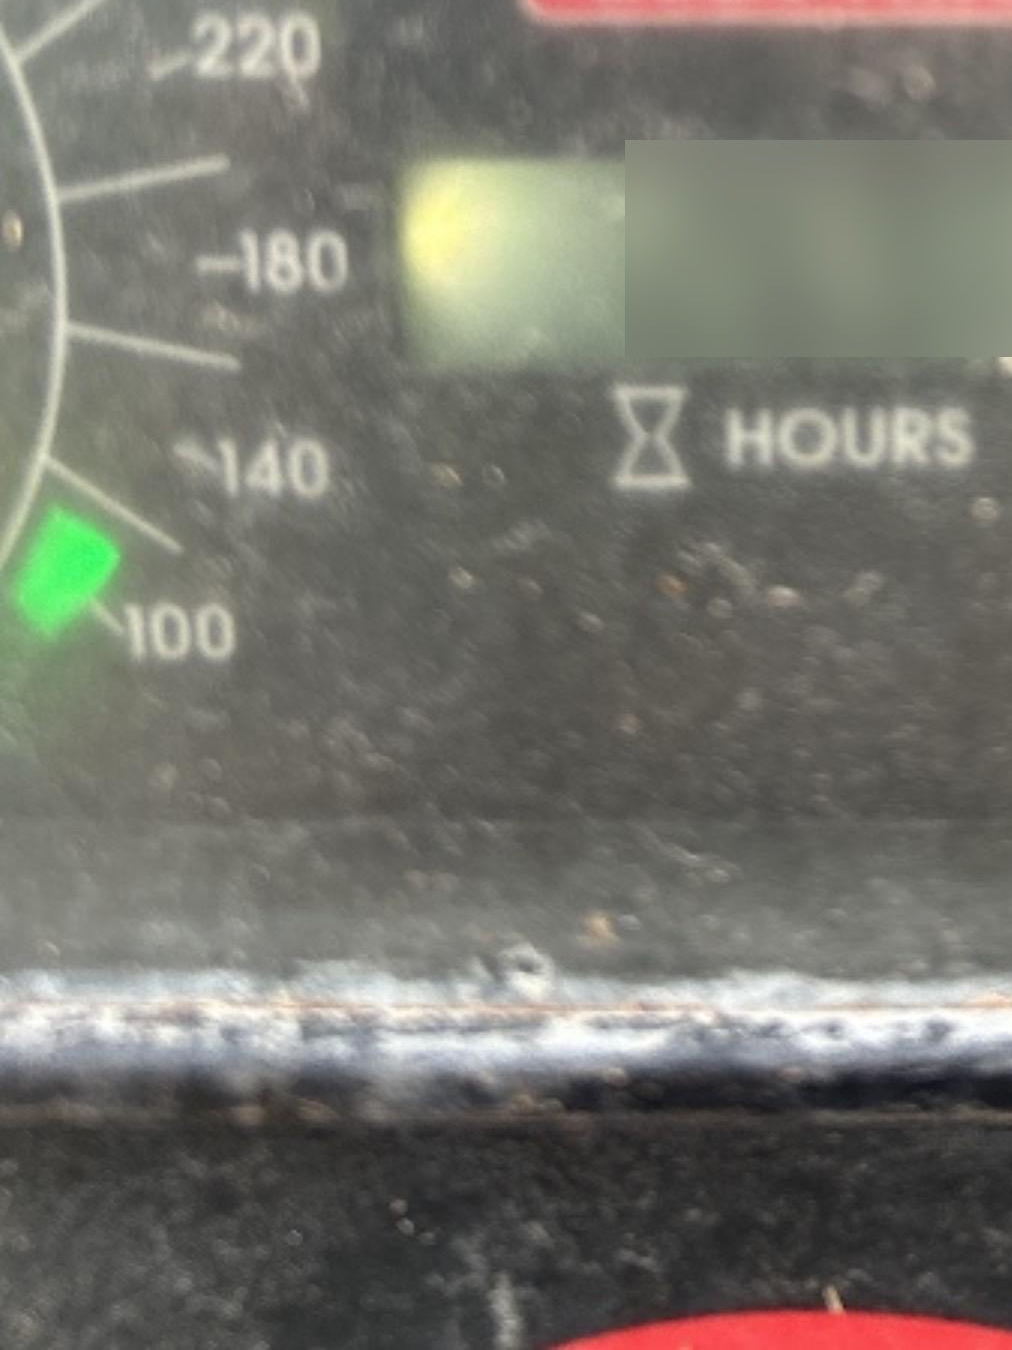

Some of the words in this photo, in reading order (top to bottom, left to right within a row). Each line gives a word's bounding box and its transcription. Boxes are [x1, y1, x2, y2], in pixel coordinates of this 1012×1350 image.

[192, 12, 323, 81] 220
[238, 228, 349, 294] 180
[216, 439, 331, 501] 140
[724, 406, 976, 470] HOURS
[122, 602, 237, 661] 100
